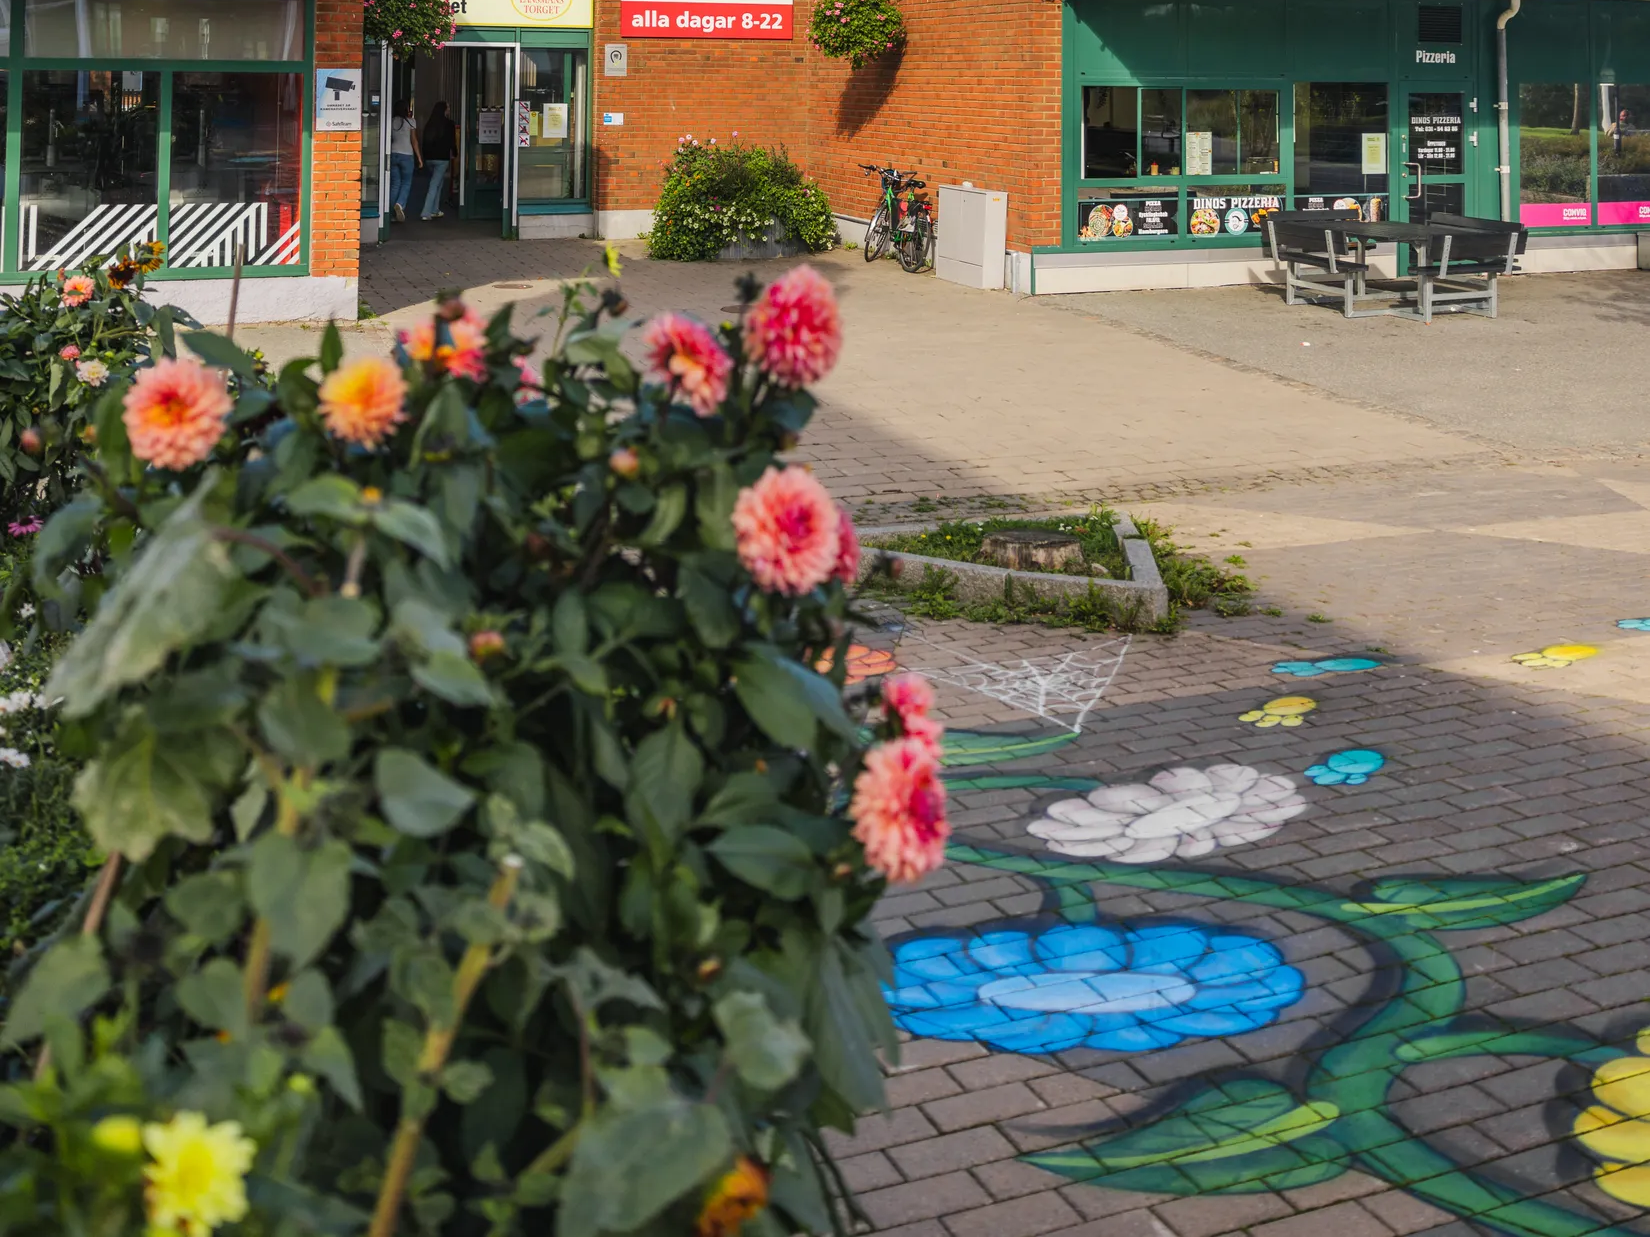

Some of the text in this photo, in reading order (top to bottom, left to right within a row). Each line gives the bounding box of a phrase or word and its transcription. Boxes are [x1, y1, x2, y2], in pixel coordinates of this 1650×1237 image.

[523, 5, 560, 14] TORGET
[631, 10, 783, 33] alla dagar 8-22
[1415, 50, 1456, 64] Pizzeria
[1411, 116, 1461, 124] DINOS PIZZERIA
[1193, 196, 1280, 210] DINOS PIZZERIA
[1563, 208, 1587, 216] COMVIQ
